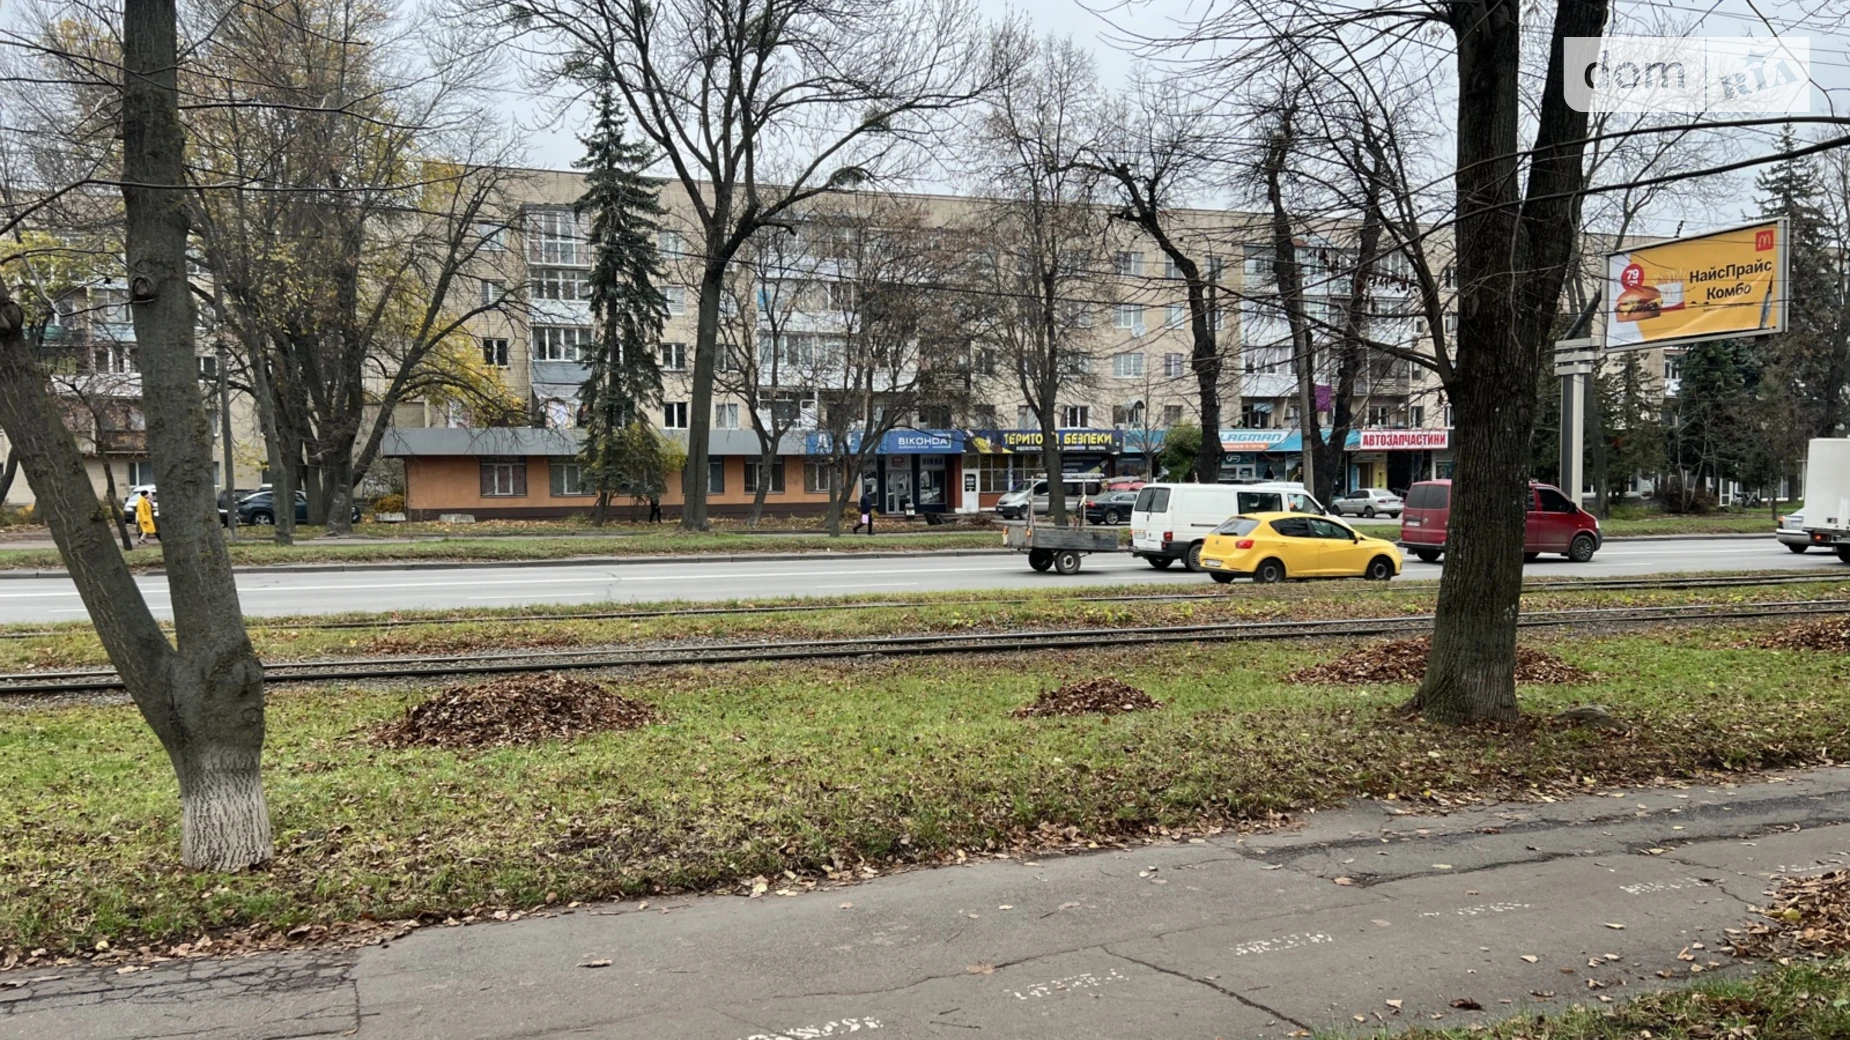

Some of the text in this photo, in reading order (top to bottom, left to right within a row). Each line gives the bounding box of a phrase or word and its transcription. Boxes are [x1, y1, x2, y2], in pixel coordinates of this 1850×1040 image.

[1626, 268, 1639, 280] 79
[1689, 259, 1773, 284] НайсПрайс
[1706, 282, 1752, 300] Комбо
[1004, 433, 1112, 445] ТЕРИТО БЕЗПЕКИ
[1362, 434, 1446, 446] АВТОЗАПЧАСТИНИ
